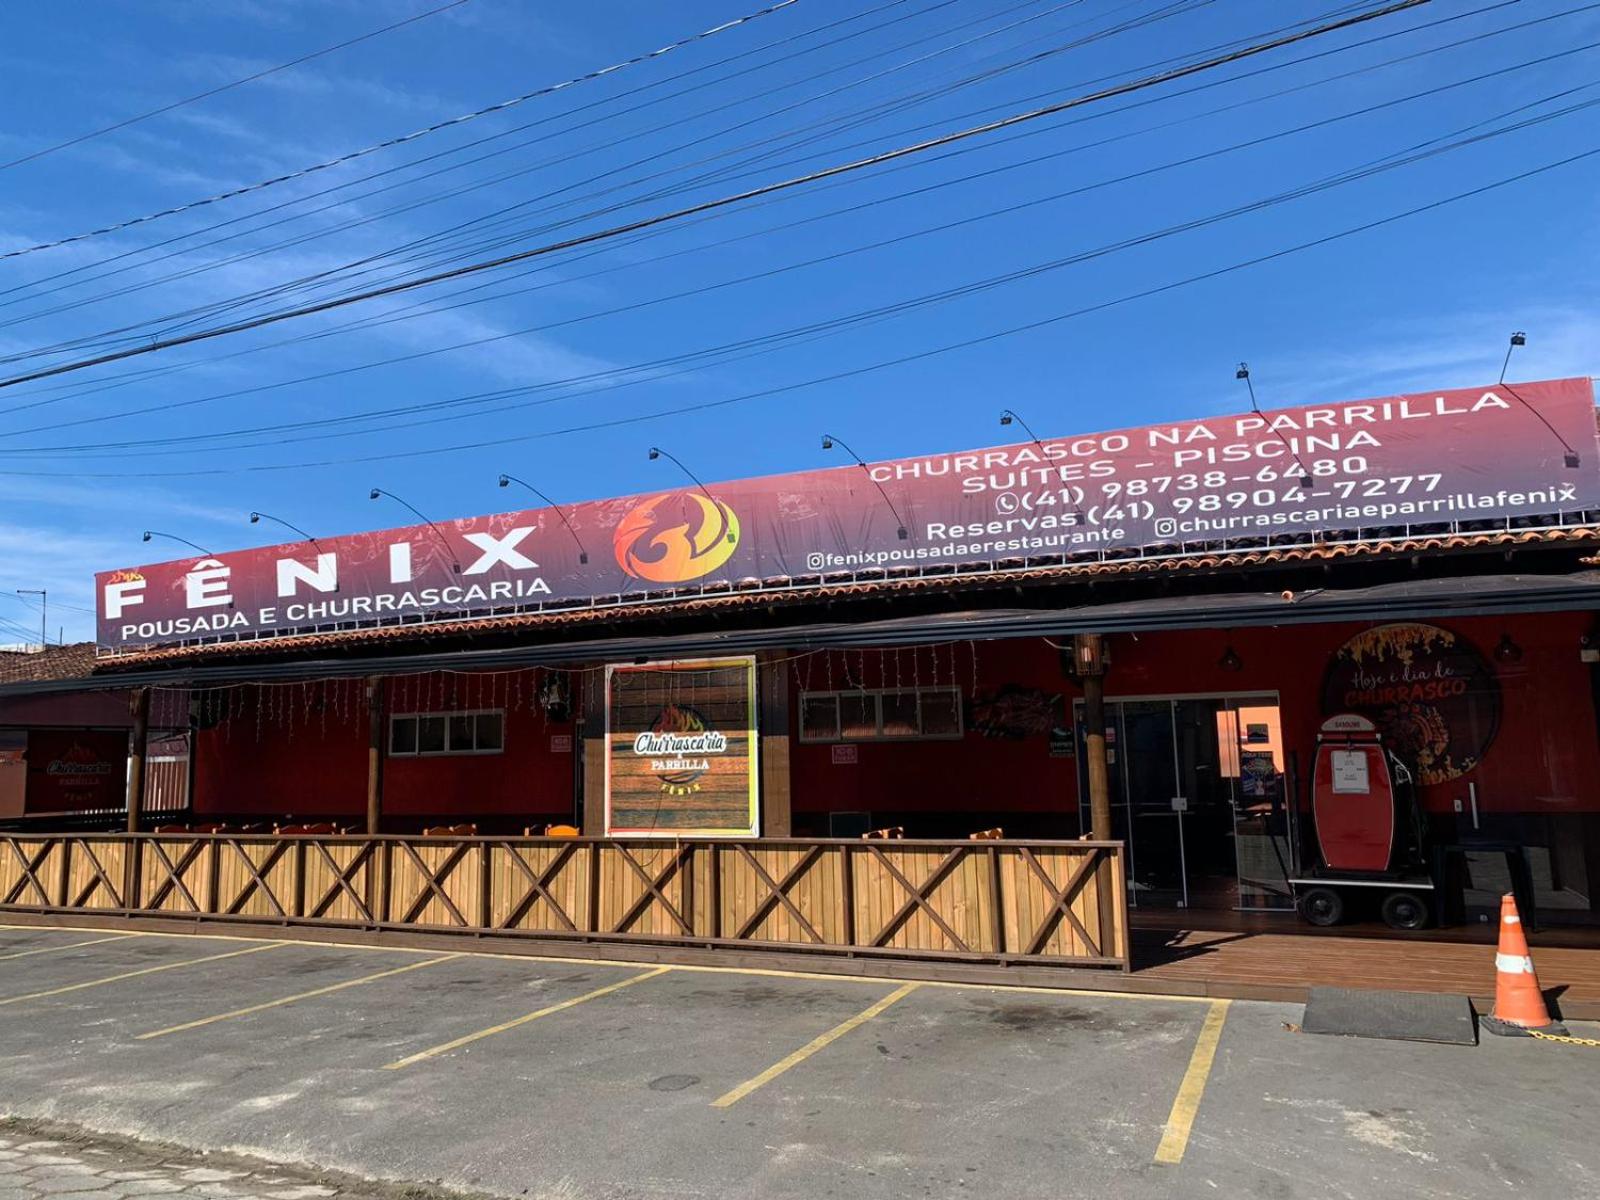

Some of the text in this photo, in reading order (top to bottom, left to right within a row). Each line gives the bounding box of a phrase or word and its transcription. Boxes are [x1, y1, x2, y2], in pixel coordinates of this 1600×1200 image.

[870, 391, 1510, 483] CHURRASCO NA PARRILLA
[962, 459, 1116, 494] SUÍTES
[1174, 429, 1382, 468] PISCINA
[927, 473, 1442, 541] Reservas (41) 98904-7277
[1022, 455, 1368, 512] (41) 98738-6480
[825, 482, 1577, 568] fenixpousadaerestaurante churrascariaeparrillafenix
[105, 525, 540, 620] FÊNIX
[121, 577, 552, 641] POUSADA E CHURRASCARIA
[1344, 679, 1467, 707] CHURRASCO
[635, 733, 725, 753] Churrascaria
[651, 758, 710, 771] PARRILLA
